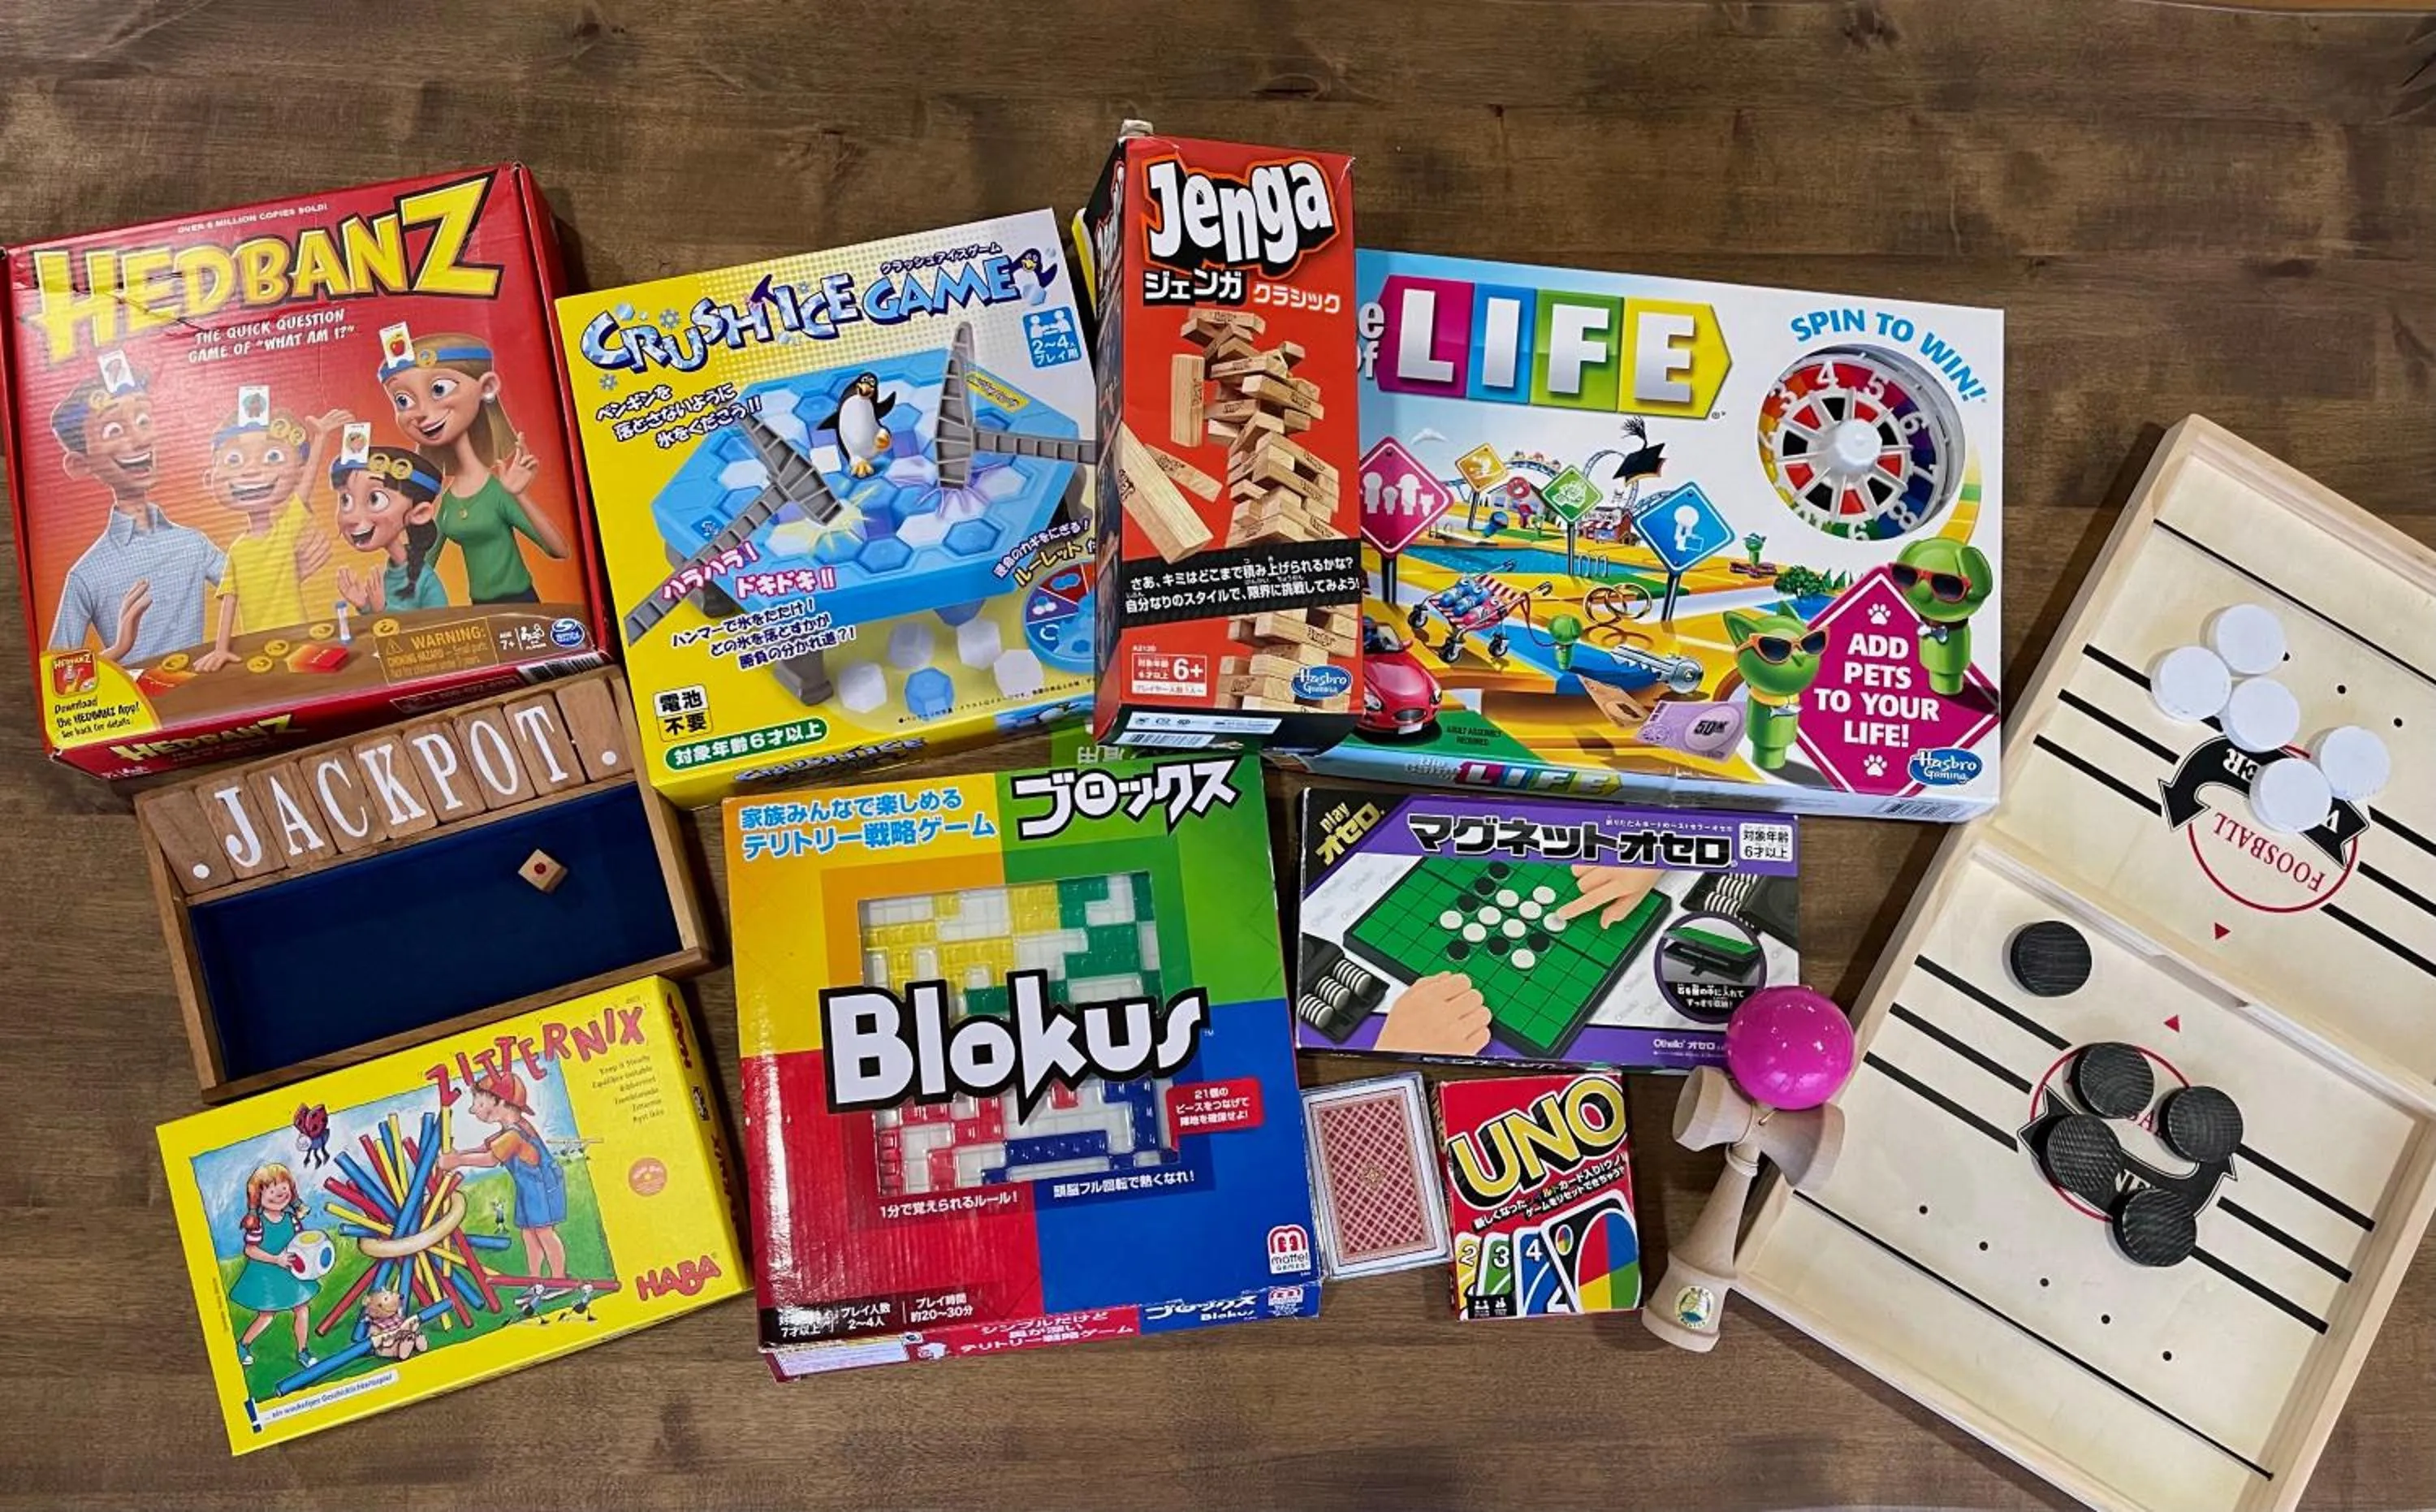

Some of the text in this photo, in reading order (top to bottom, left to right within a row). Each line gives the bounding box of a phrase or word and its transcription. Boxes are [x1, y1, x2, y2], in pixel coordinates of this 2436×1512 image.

[214, 214, 257, 227] MILLION
[259, 208, 296, 221] COPIES
[1147, 161, 1335, 266] Jenga
[24, 171, 502, 364] HEDBANZ
[880, 241, 1004, 275] クラッシュアイスゲーム
[1143, 269, 1245, 301] ジェンガ
[1252, 283, 1341, 314] クラシック
[195, 308, 345, 345] THE QUICK QUESTION
[580, 255, 1021, 375] CRUSH ICE GAME
[188, 347, 229, 364] GAME
[234, 340, 252, 356] OF
[307, 329, 329, 344] AM
[1396, 287, 1696, 404] LIFE
[1790, 309, 1988, 403] SPIN TO WIN!
[596, 384, 673, 423] ペンギンを
[612, 382, 738, 442] 落とさないように
[655, 395, 763, 449] 氷をくだこう!!
[662, 540, 760, 600] ハラハラ!
[735, 566, 836, 600] ドキドキ!!
[410, 626, 487, 650] WARNING:
[672, 598, 816, 648] ハンマーで氷をたたけ!
[1847, 633, 1910, 660] ADD
[1173, 657, 1205, 681] 6+
[1299, 667, 1349, 685] Hasbro
[1843, 662, 1912, 689] PETS
[54, 698, 98, 715] Download
[659, 690, 704, 713] 電池
[1813, 687, 1941, 723] TO YOUR
[663, 711, 707, 737] 不要
[1843, 719, 1911, 749] LIFE!
[673, 720, 823, 766] 対象年齢6才以上
[1916, 750, 1978, 772] Hasbro
[1922, 767, 1971, 785] Gaming
[740, 788, 964, 832] 家族みんなで楽しめる
[1012, 758, 1241, 840] ブロックス
[1315, 801, 1382, 866] オセロ
[1320, 801, 1351, 835] play
[742, 812, 997, 862] テリトリー戦略ゲーム
[1406, 812, 1733, 868] マグネットオセロ
[1743, 830, 1790, 845] 対象年齢
[1743, 844, 1790, 860] 6才以上
[2213, 811, 2327, 893] FOOSBALL
[425, 1005, 646, 1107] ZITTERNIX
[823, 972, 1205, 1112] Blokus
[1175, 1097, 1250, 1116] ピースをつなげて
[1449, 1076, 1626, 1200] UNO
[1053, 1169, 1196, 1199] 頭脳フル回転で熱くなれ!
[879, 1189, 1019, 1220] 1分で覚えられるルール!
[1461, 1244, 1478, 1267] 2
[1492, 1244, 1510, 1268] 3
[1525, 1238, 1543, 1263] 4
[635, 1255, 723, 1302] HABA
[841, 1302, 892, 1318] プレイ人数
[915, 1292, 968, 1308] プレイ時間
[1199, 1308, 1256, 1322] Blokus
